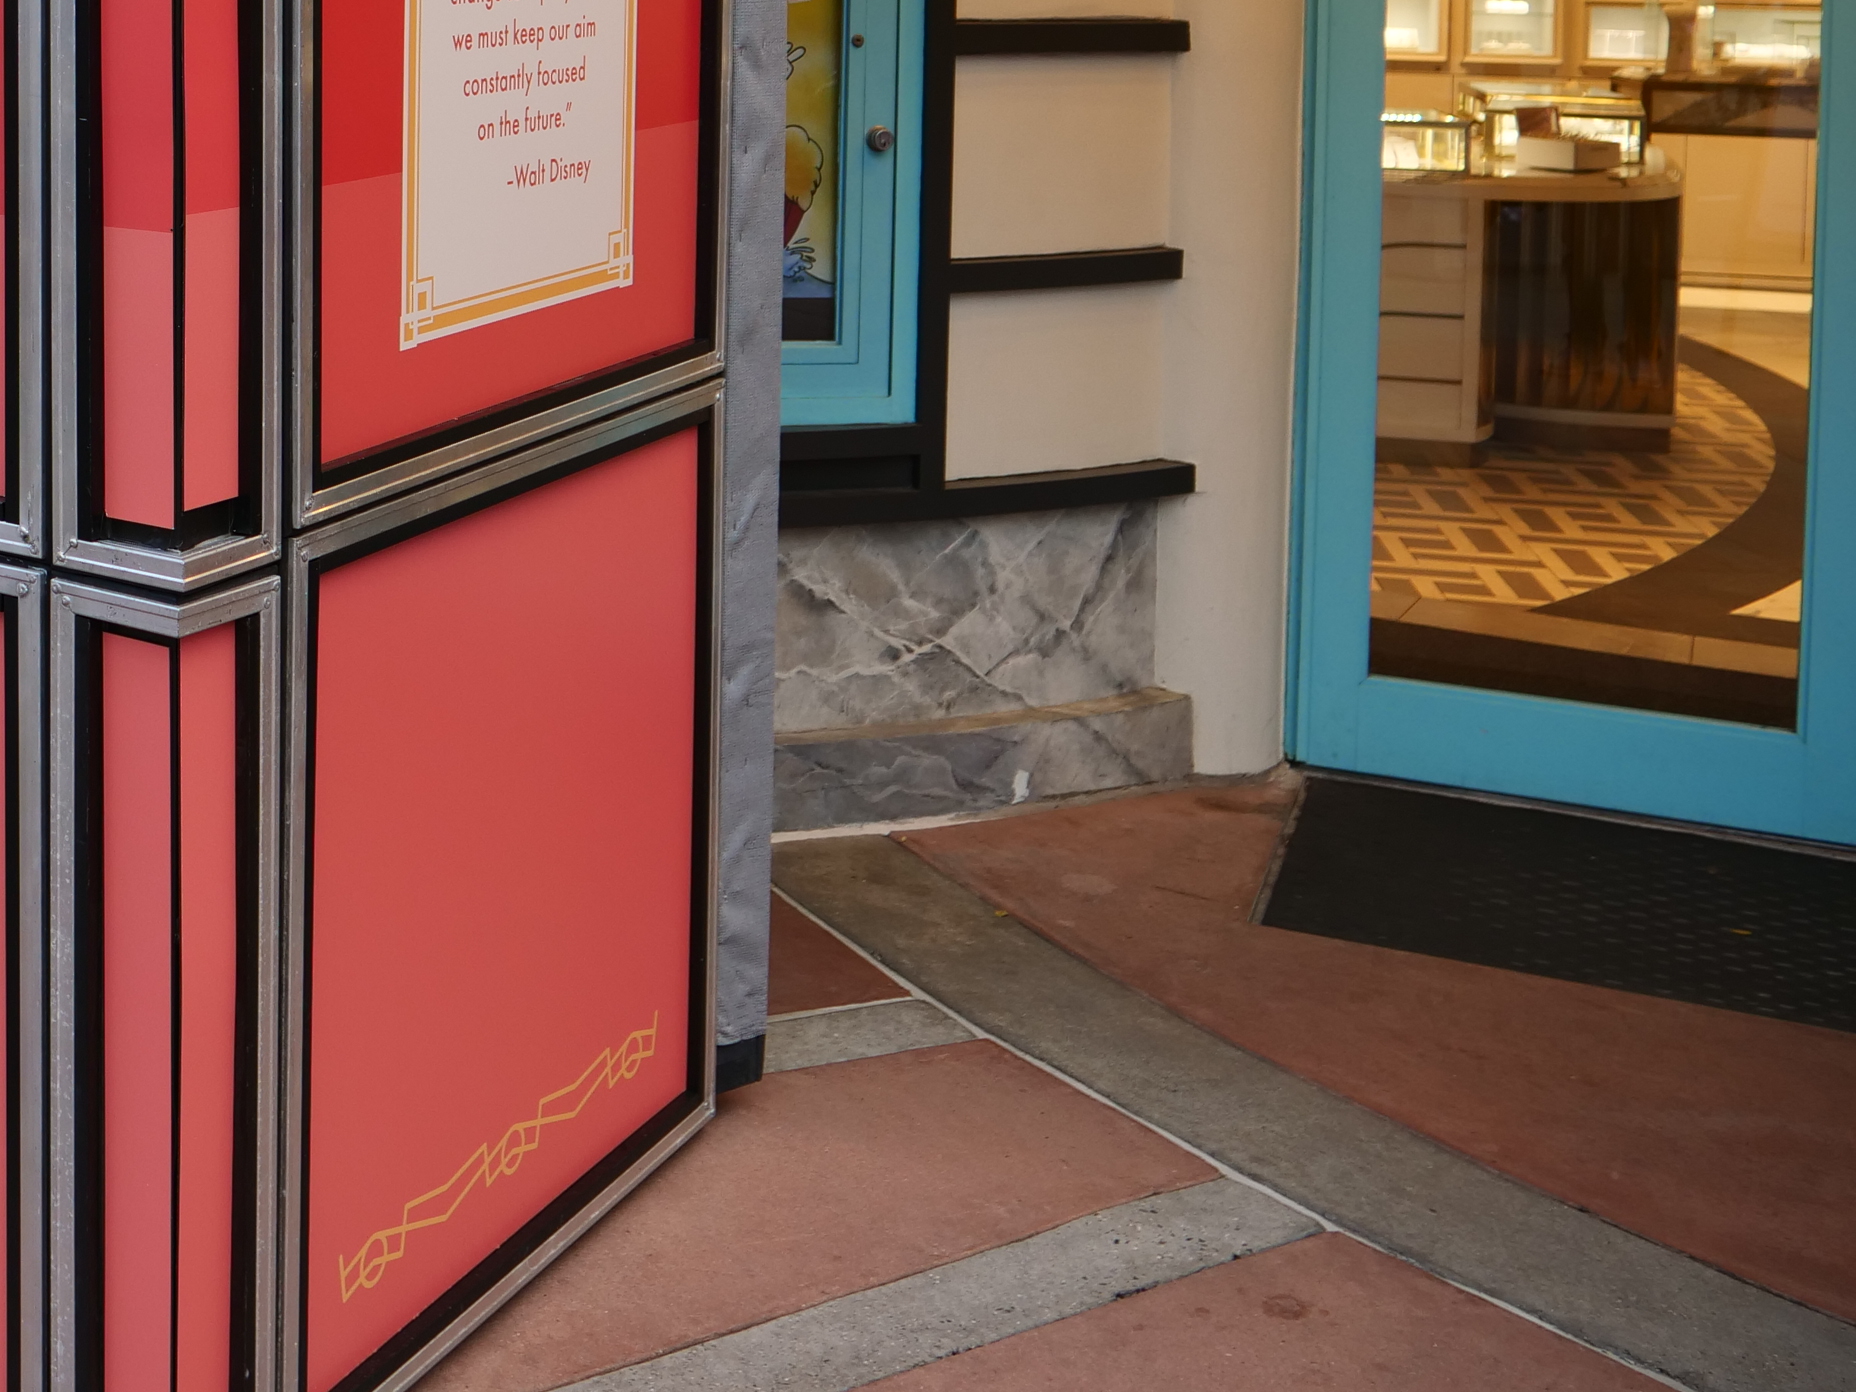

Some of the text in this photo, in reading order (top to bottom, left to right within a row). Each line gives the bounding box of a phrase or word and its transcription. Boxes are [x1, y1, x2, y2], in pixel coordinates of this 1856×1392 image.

[452, 15, 596, 51] we must keep our aim
[463, 55, 586, 97] constantly focused
[477, 122, 494, 141] on
[499, 110, 520, 137] the
[550, 157, 591, 184] Disney
